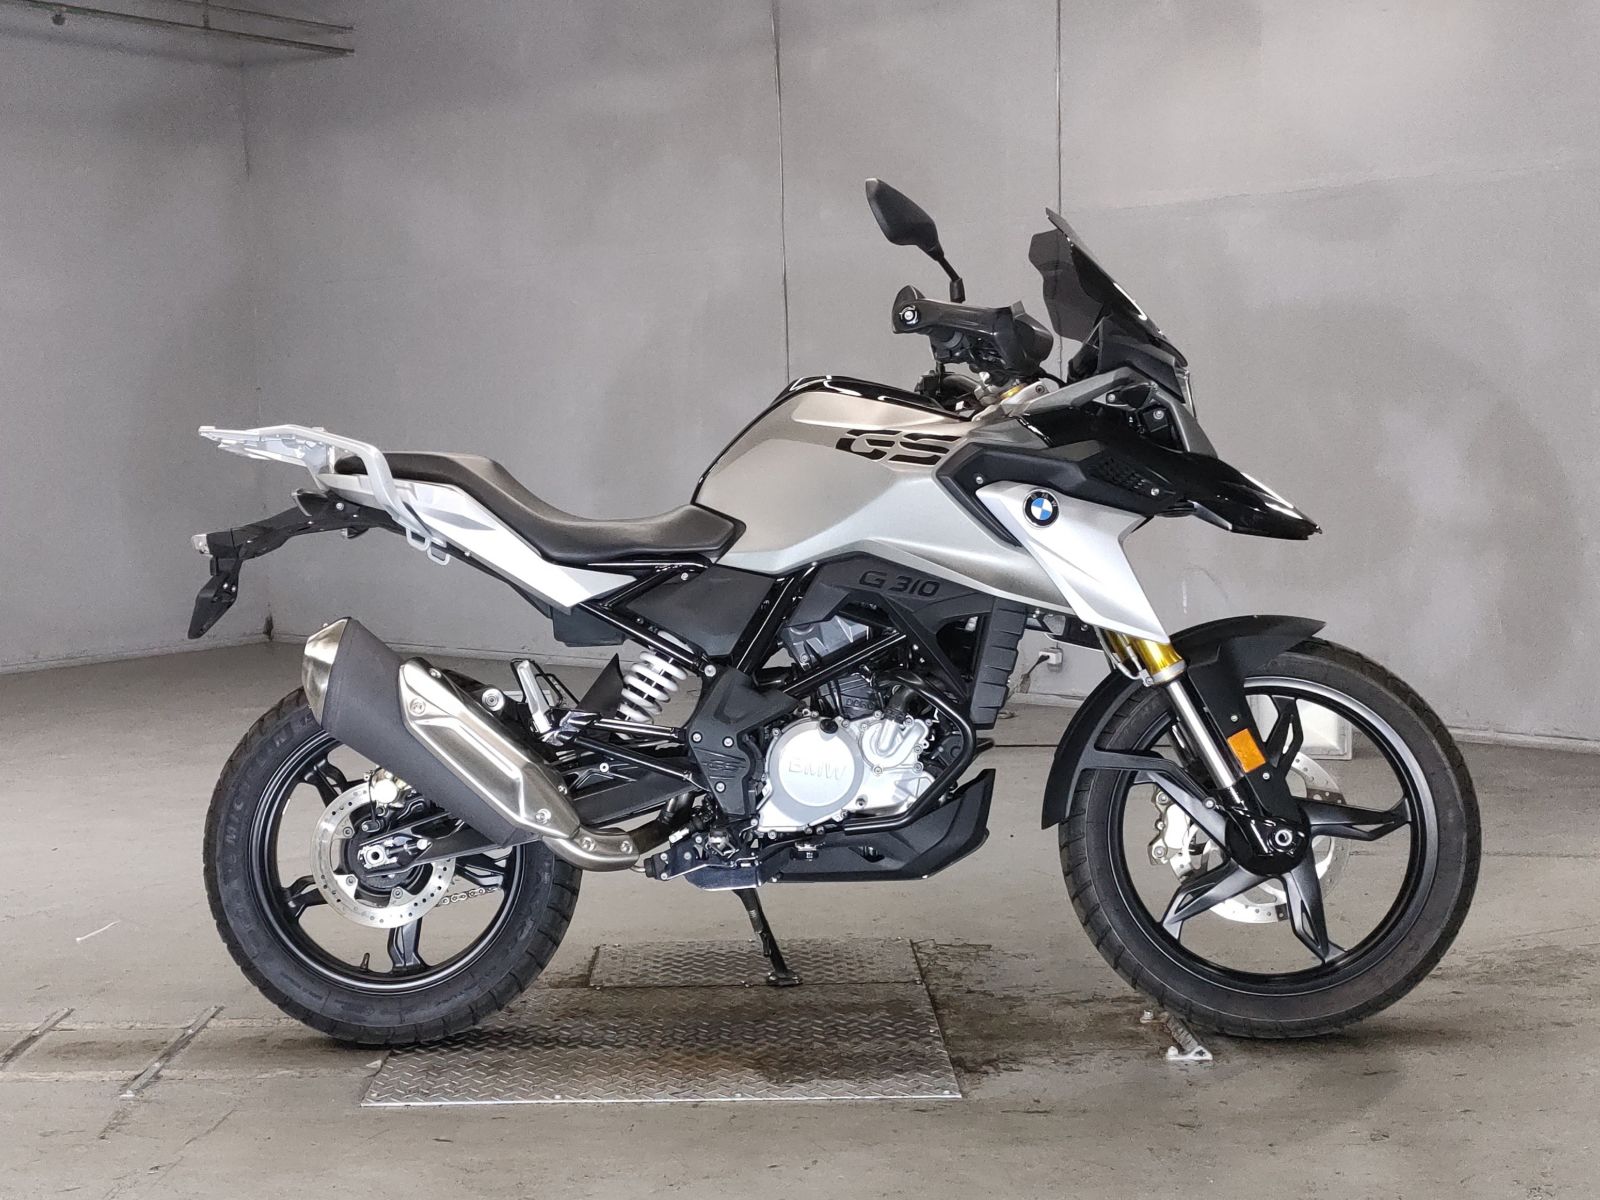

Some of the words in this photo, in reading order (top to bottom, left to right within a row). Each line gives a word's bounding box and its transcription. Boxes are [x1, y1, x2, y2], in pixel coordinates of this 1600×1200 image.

[836, 429, 962, 466] GS
[859, 570, 888, 589] G
[888, 575, 941, 597] 310
[788, 756, 848, 781] BMW
